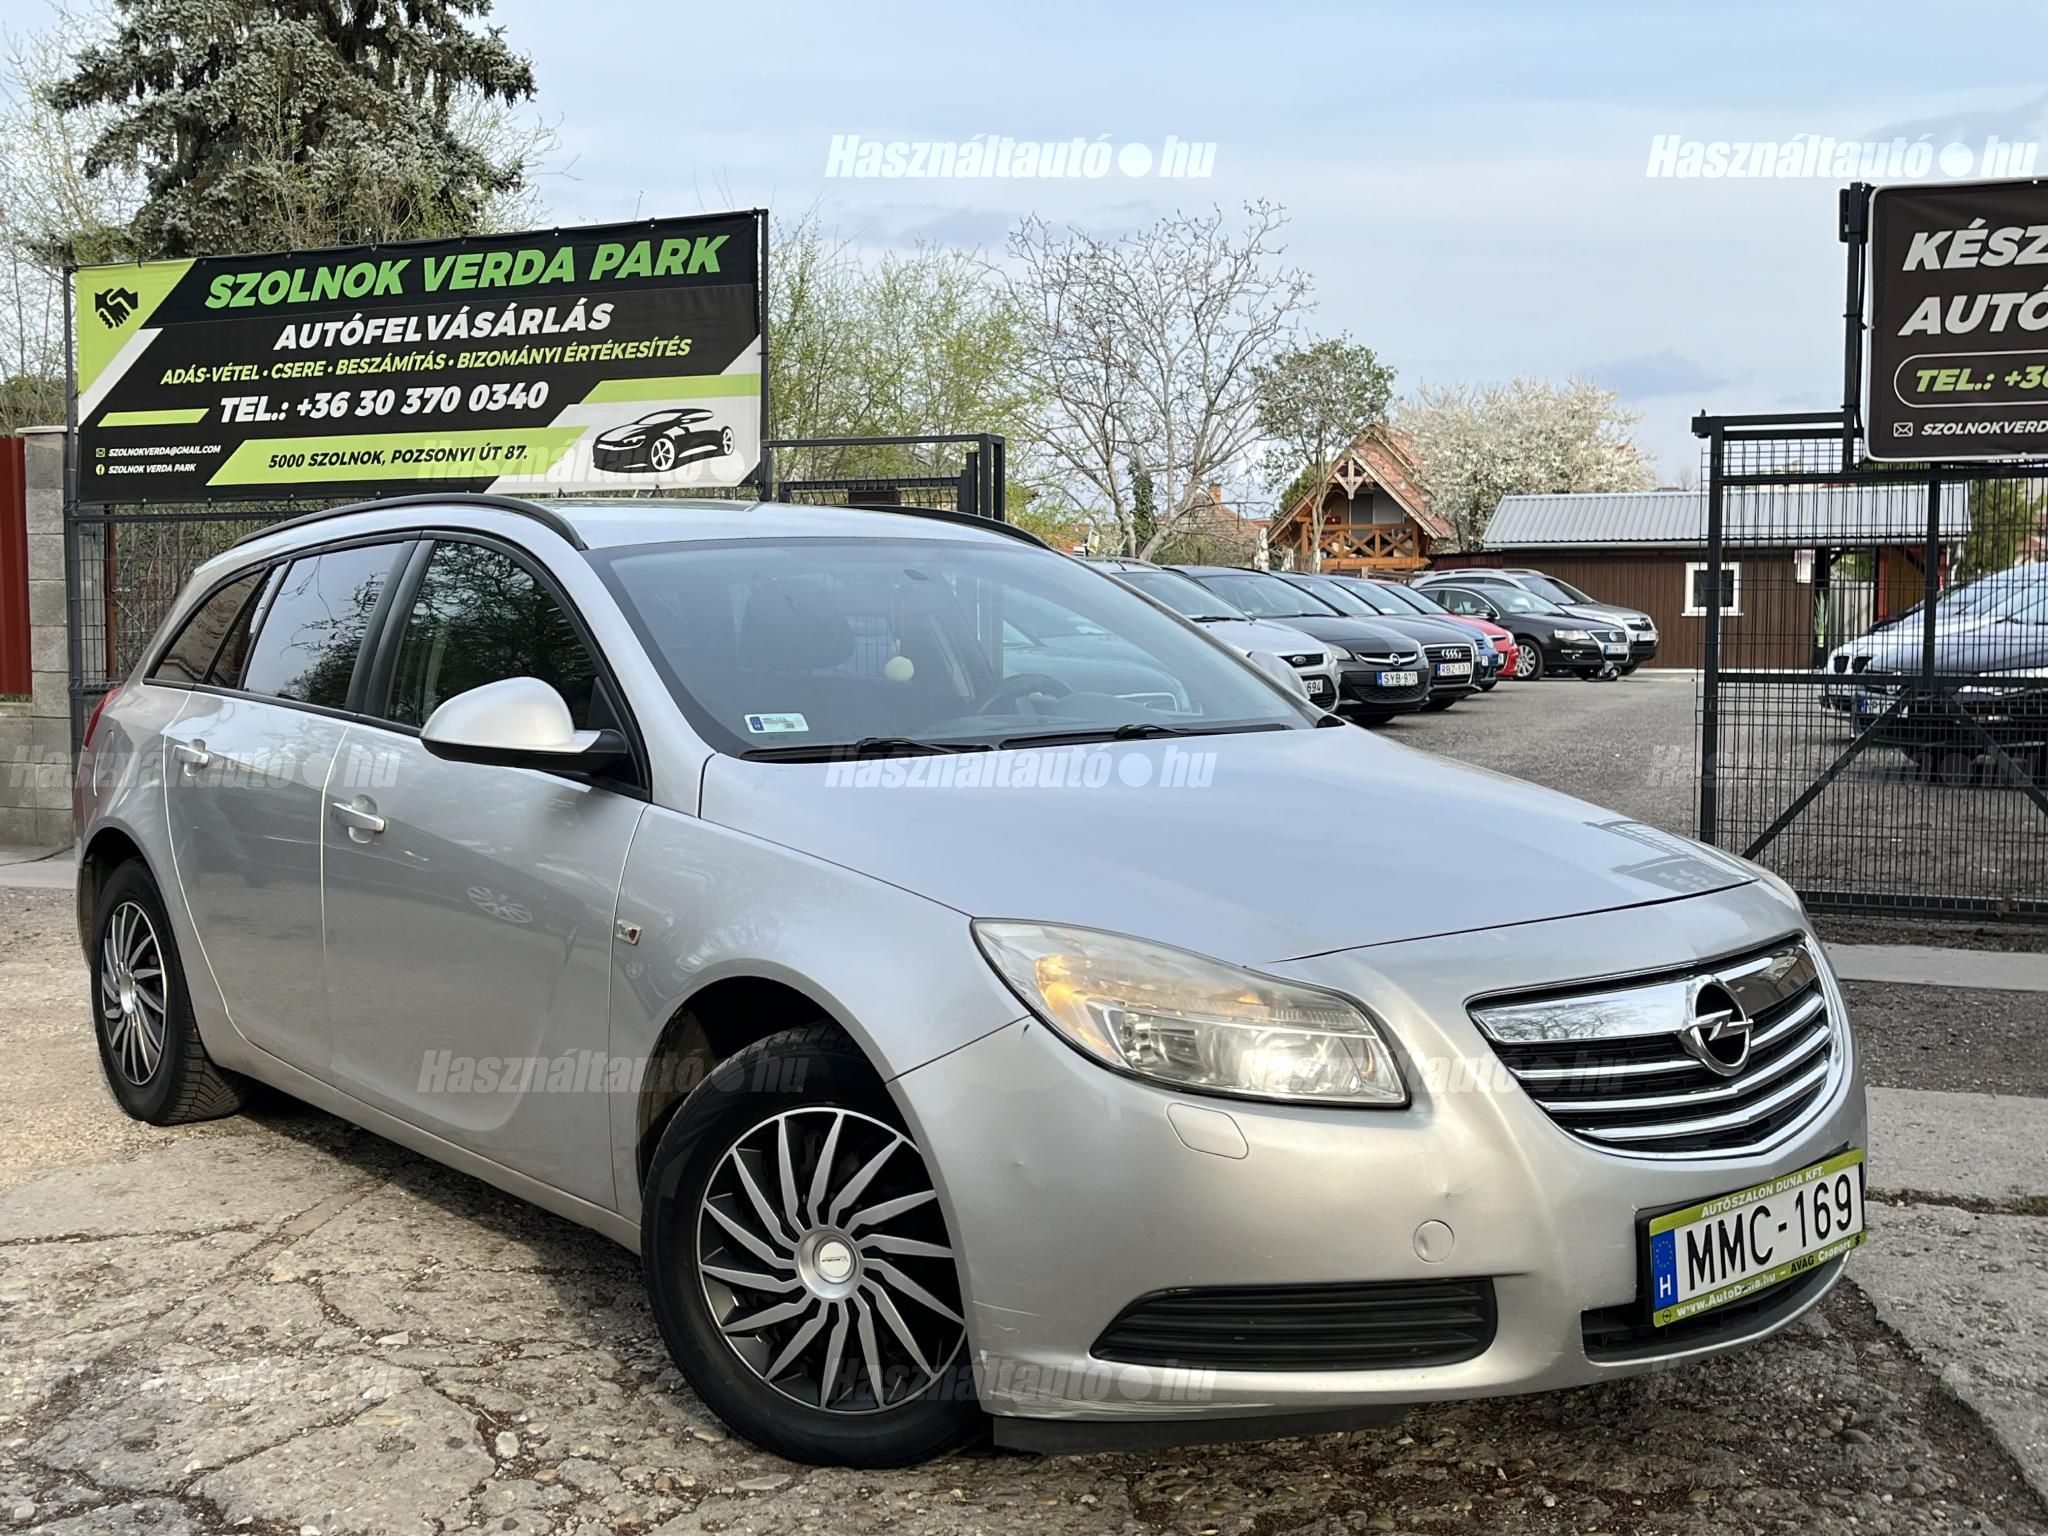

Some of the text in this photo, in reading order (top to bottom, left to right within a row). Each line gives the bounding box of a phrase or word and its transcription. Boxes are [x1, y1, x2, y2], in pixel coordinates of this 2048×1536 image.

[204, 235, 730, 309] SZOLNOK VERDA PARK
[273, 297, 614, 351] AUTÓFELVÁSÁRLÁS
[160, 336, 692, 385] ADÁS-VÉTEL CSERE BESZÁMÍTÁS BIZOMÁNYI ÉRTÉKESÍTÉS
[1916, 367, 1995, 392] TEL.:
[220, 381, 550, 424] TEL.: +36 30 370 0340
[108, 445, 221, 457] SZOLNOKVERDA@GMAIL.COM
[268, 443, 528, 468] 5000 SZOLNOK, POZSONYI ÚT 87.
[108, 463, 196, 474] SZOLNOK VERDA PARK
[1701, 1166, 1825, 1218] AUTÓSZALON DUNA KFT.
[1686, 1173, 1852, 1291] MMC-169
[1791, 1255, 1815, 1274] AVAG
[1659, 1274, 1671, 1299] H
